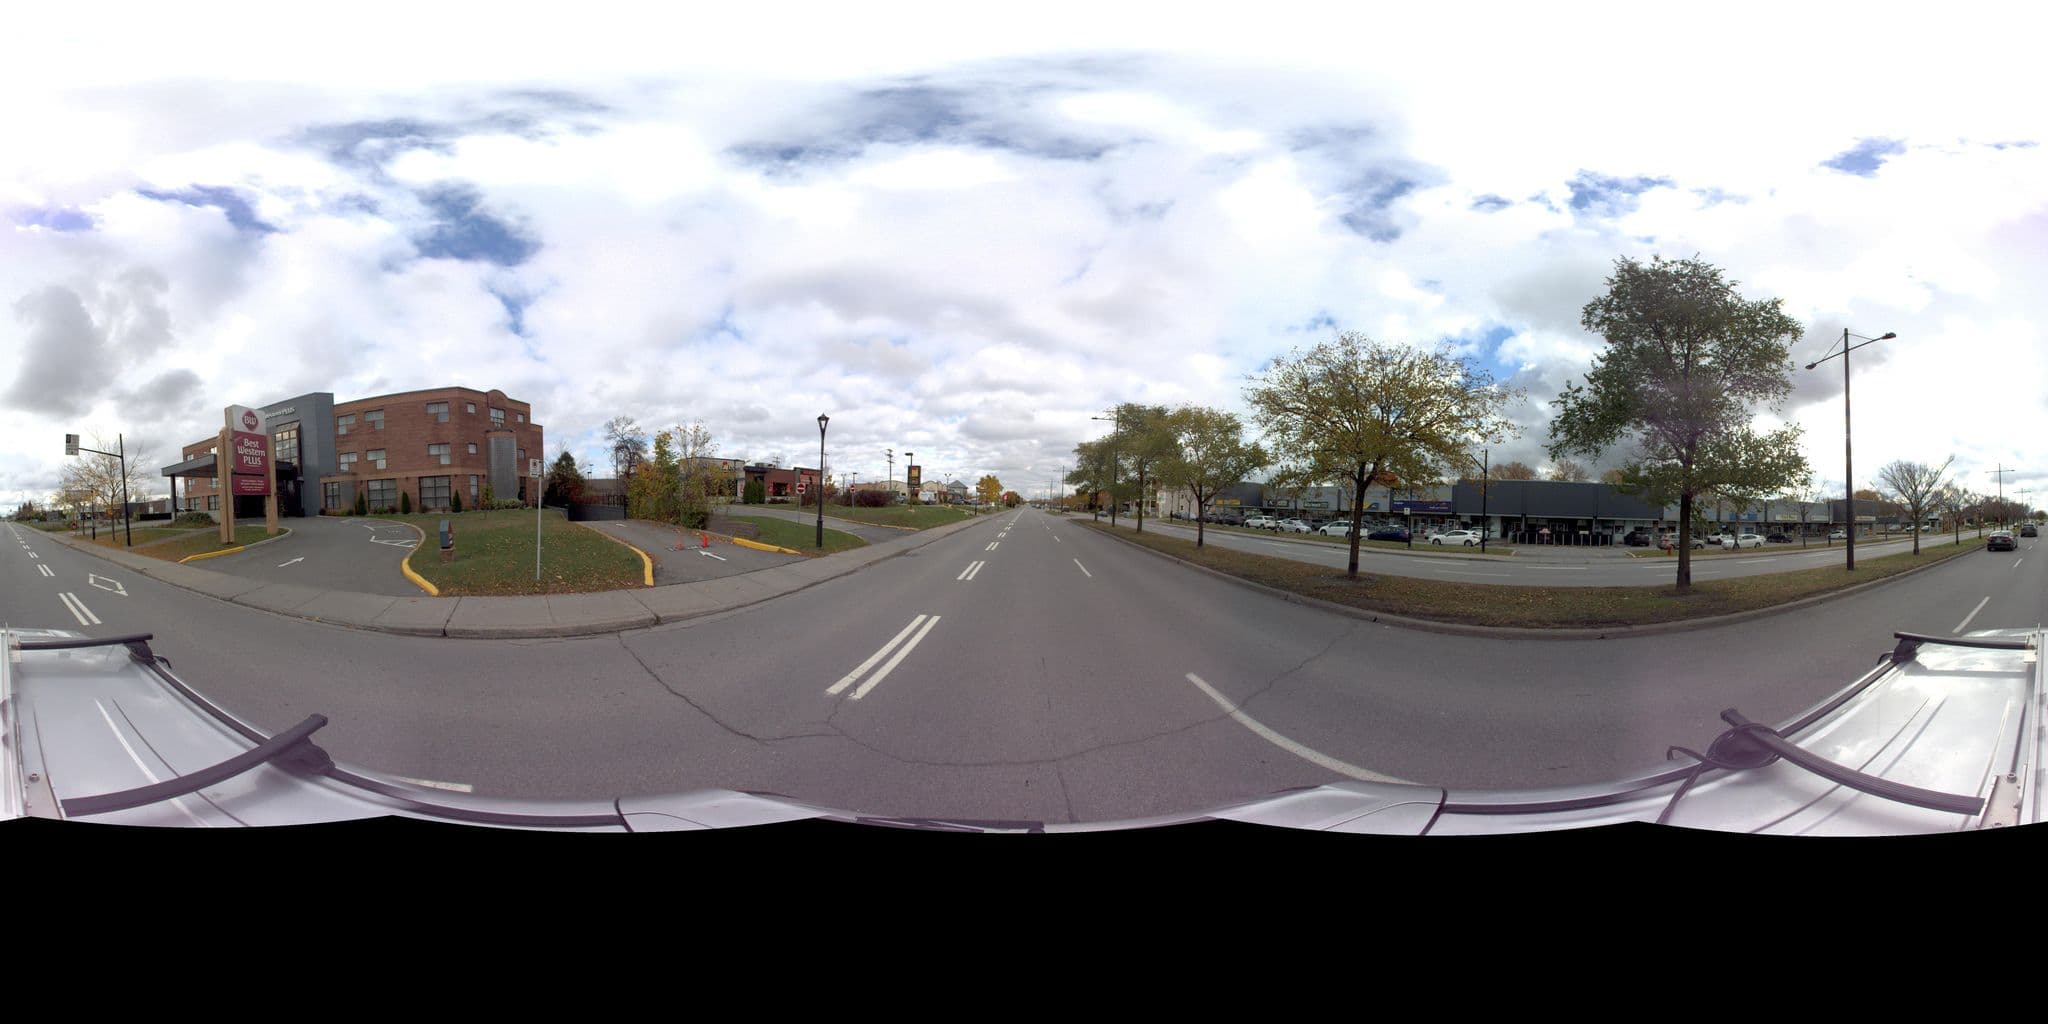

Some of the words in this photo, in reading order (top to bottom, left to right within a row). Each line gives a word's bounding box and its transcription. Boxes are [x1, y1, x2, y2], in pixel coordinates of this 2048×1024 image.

[244, 438, 259, 449] Best
[237, 445, 266, 457] Western
[243, 456, 262, 465] PLUS
